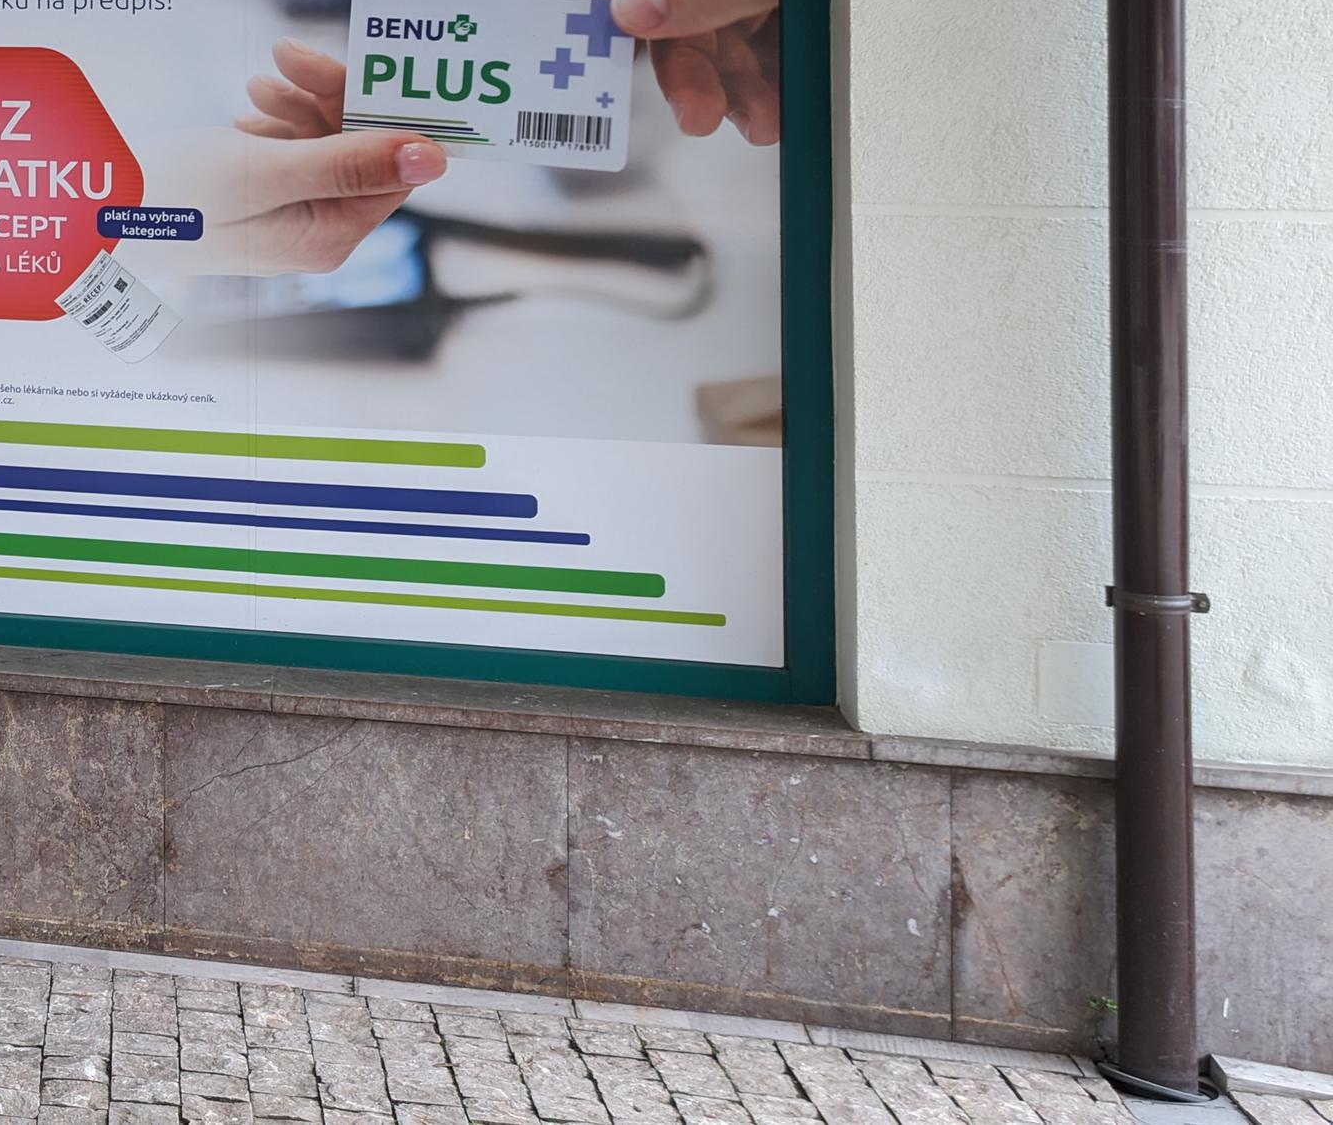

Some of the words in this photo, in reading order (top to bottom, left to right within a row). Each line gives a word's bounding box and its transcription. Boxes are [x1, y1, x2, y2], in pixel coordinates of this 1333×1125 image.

[366, 17, 445, 41] BENU
[362, 54, 511, 104] PLUS
[523, 140, 557, 149] 150012
[104, 210, 130, 222] platí
[133, 213, 146, 222] na
[148, 211, 196, 224] vybrané
[121, 225, 178, 238] kategorie
[5, 249, 62, 275] LÉKŮ
[83, 281, 106, 304] RECEPT
[23, 385, 64, 396] lékárníka
[66, 387, 89, 397] nebo
[91, 388, 98, 397] si
[100, 388, 143, 401] vyžádejte
[145, 391, 188, 403] ukázkový
